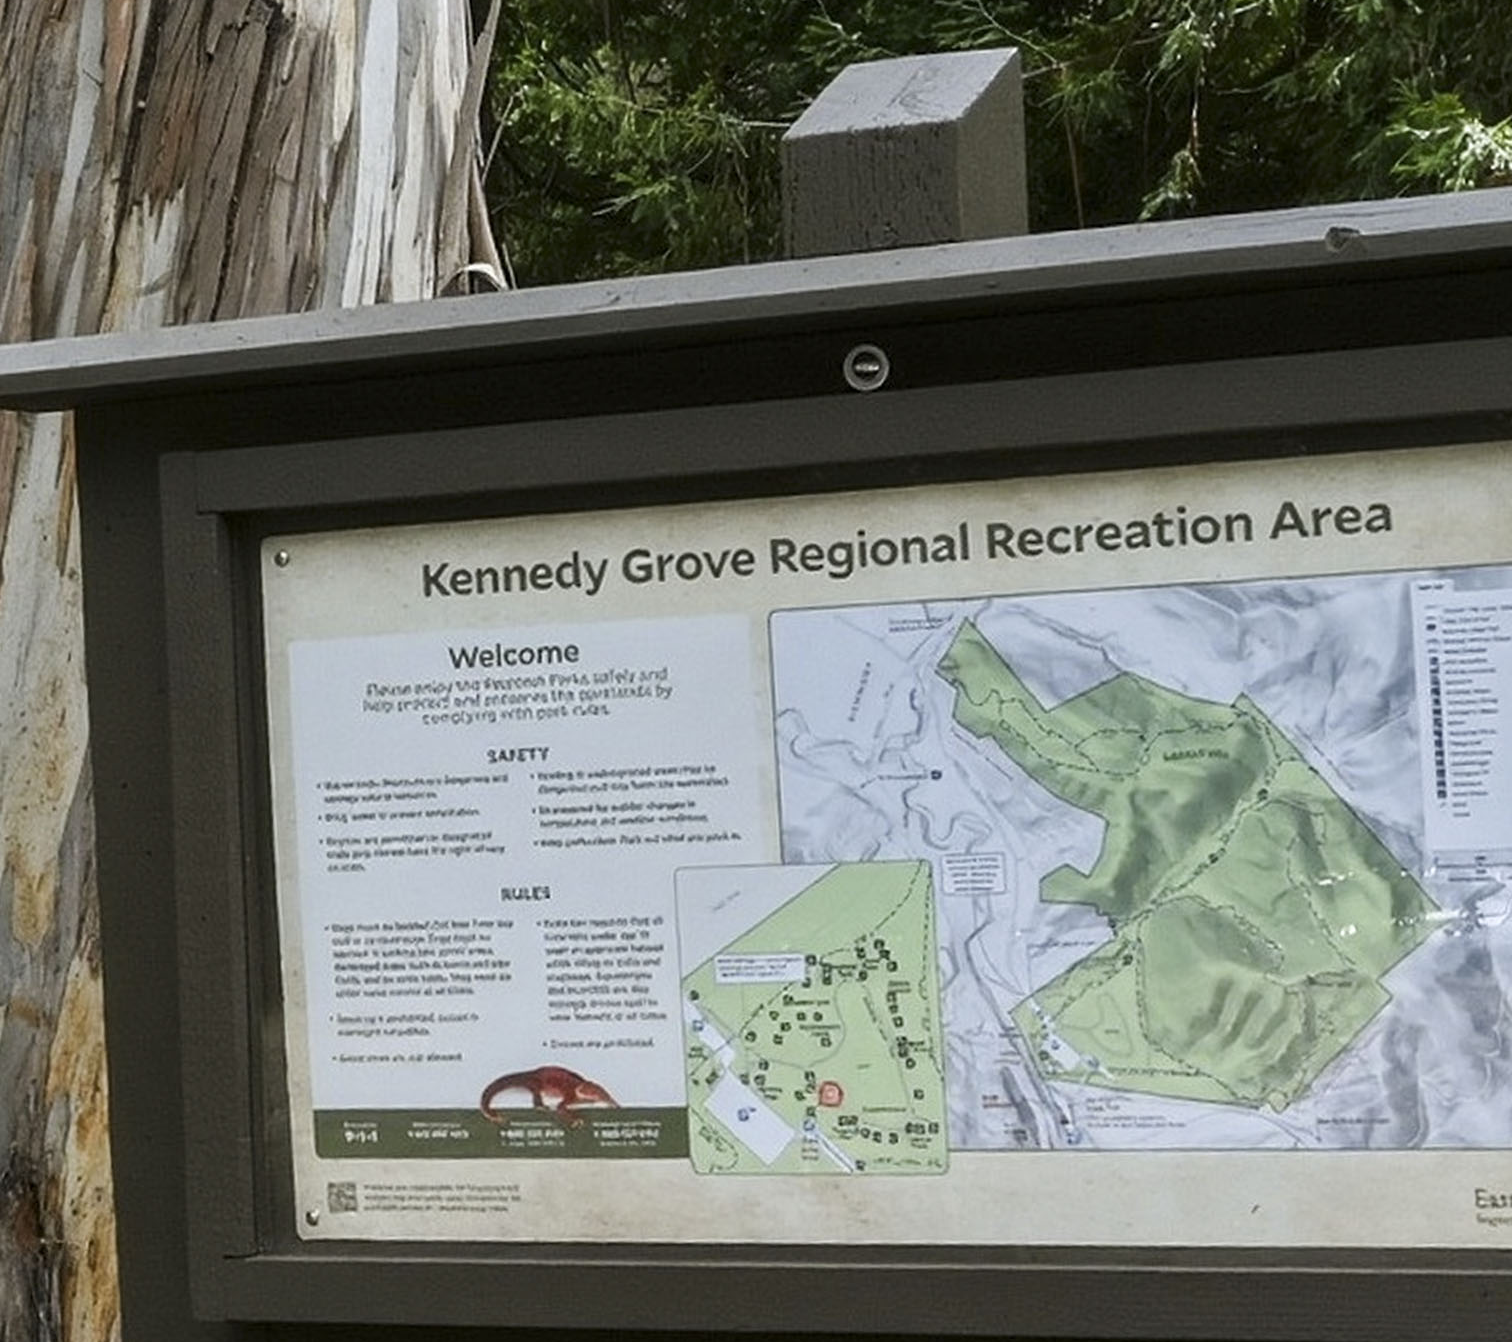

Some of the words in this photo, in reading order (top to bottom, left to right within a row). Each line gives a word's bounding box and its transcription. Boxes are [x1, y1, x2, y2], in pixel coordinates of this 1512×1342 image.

[422, 551, 609, 597] Kennedy
[622, 548, 756, 585] Grove
[769, 522, 971, 580] Regional
[986, 506, 1254, 560] Recreation
[1269, 501, 1393, 540] Area
[448, 643, 580, 669] Welcome
[486, 747, 551, 764] SAFETY
